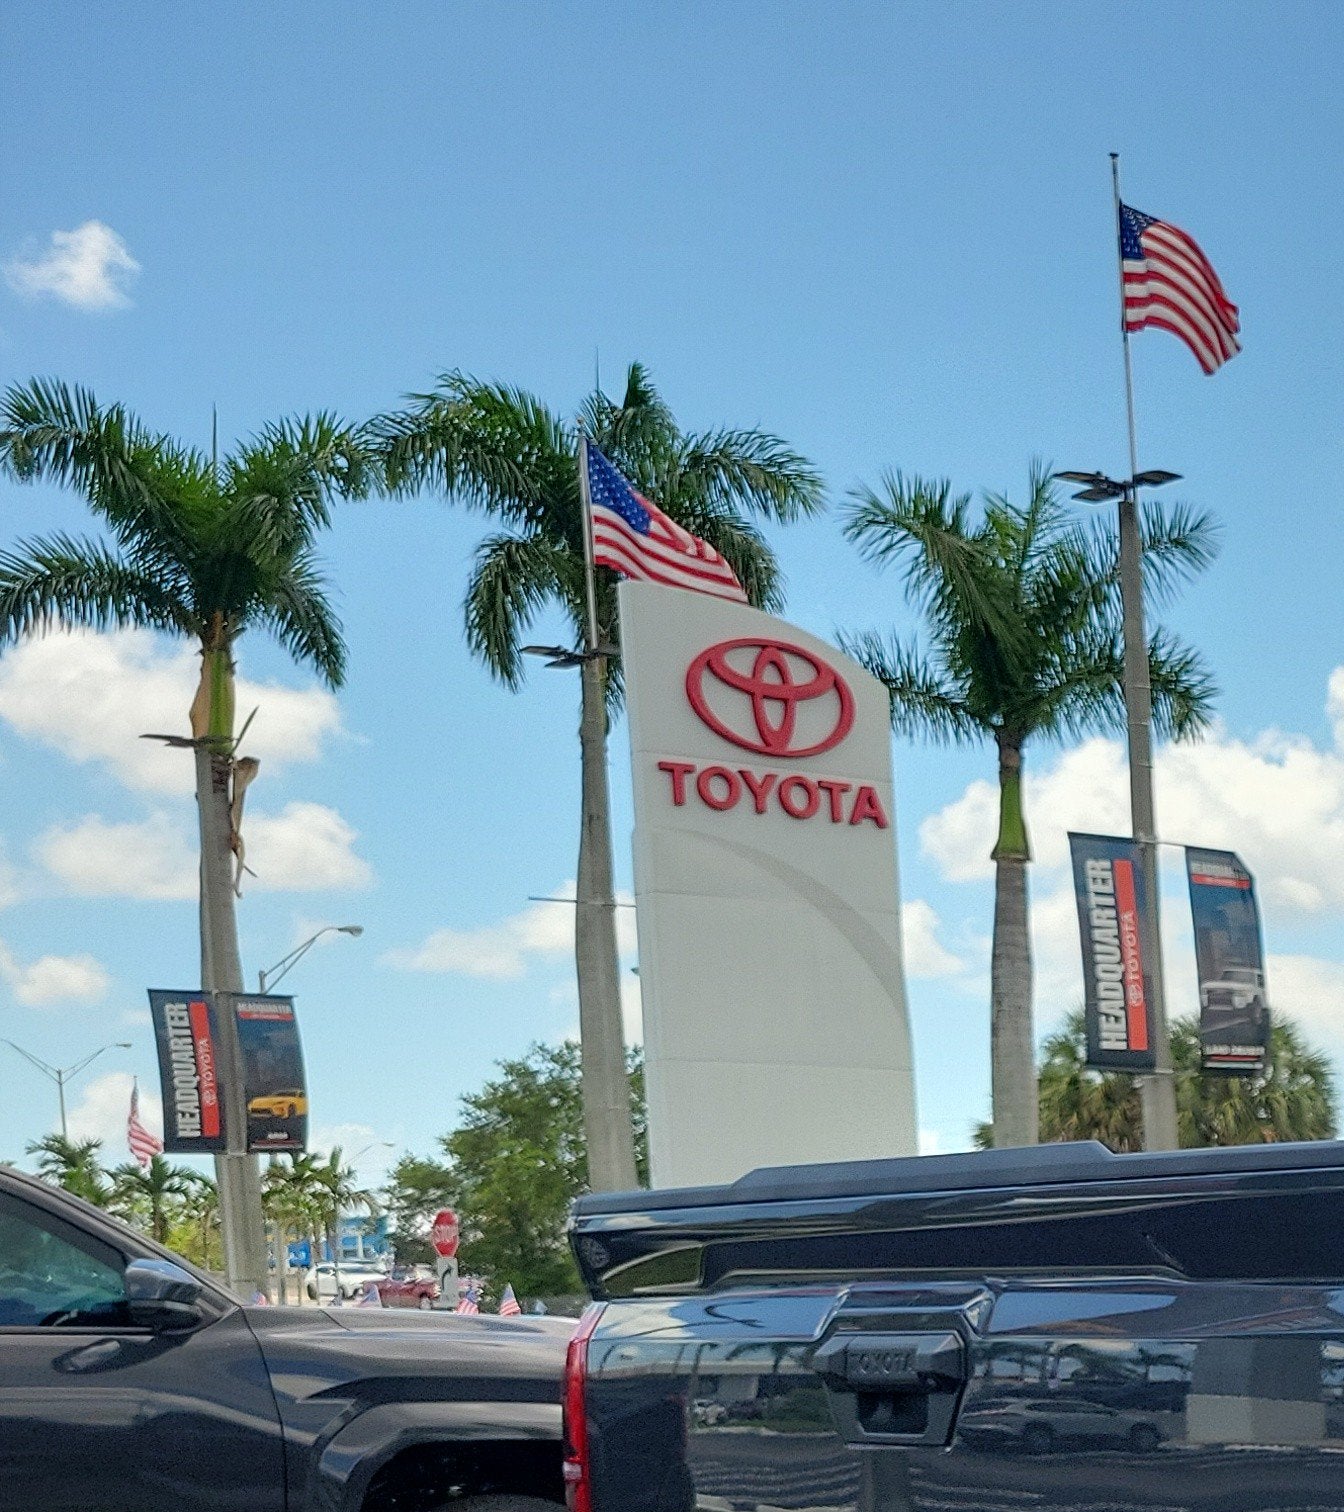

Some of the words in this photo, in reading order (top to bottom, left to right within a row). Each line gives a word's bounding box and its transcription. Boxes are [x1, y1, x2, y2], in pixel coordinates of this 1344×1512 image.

[658, 761, 889, 828] TOYOTA
[1086, 859, 1128, 1050] HEADQUARTER
[1121, 911, 1139, 981] TOYOTA
[164, 1003, 201, 1137] HEADQUARTER
[199, 1039, 217, 1091] TOYOTA
